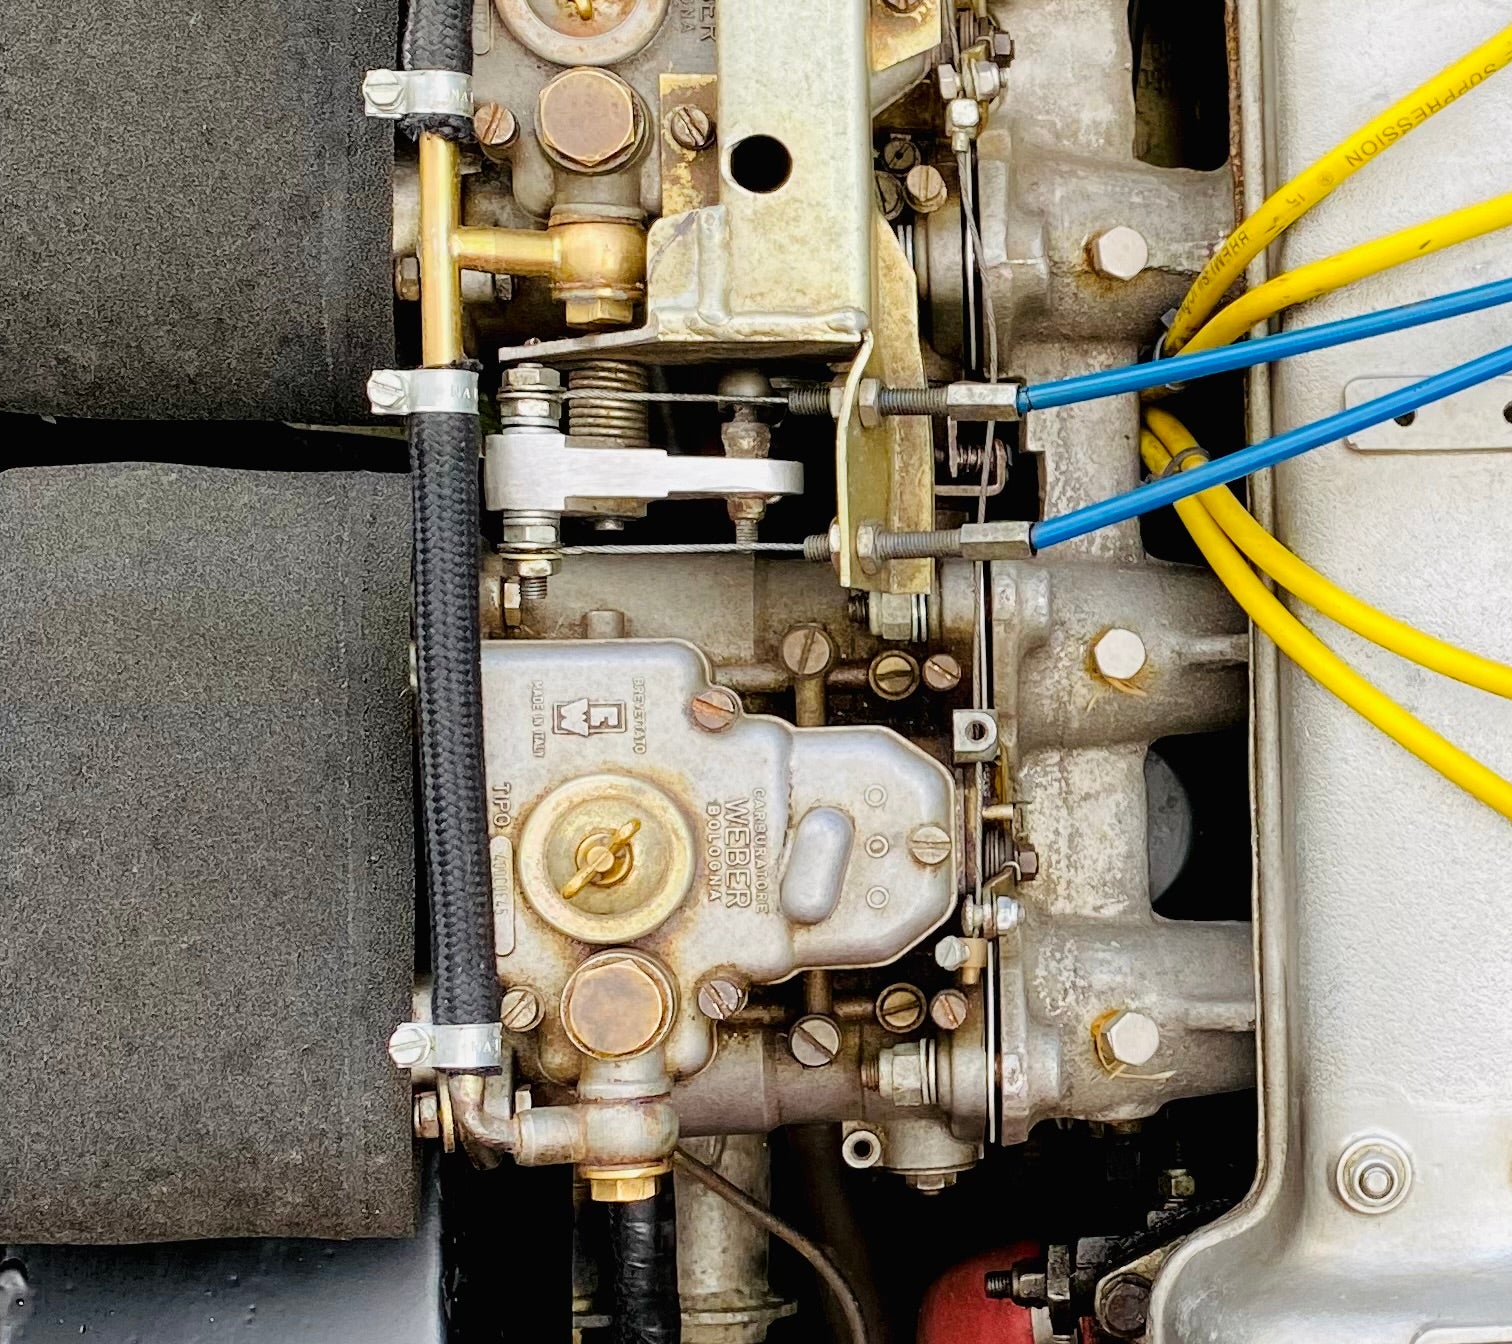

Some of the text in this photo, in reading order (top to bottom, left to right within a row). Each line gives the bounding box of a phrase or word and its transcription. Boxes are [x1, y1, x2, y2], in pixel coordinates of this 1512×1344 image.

[1343, 61, 1498, 169] SUPPRESSION
[493, 781, 512, 829] TIPO
[707, 800, 722, 902] BOLOGNA
[725, 796, 752, 910] WEBER
[753, 786, 769, 914] CARBURATORE
